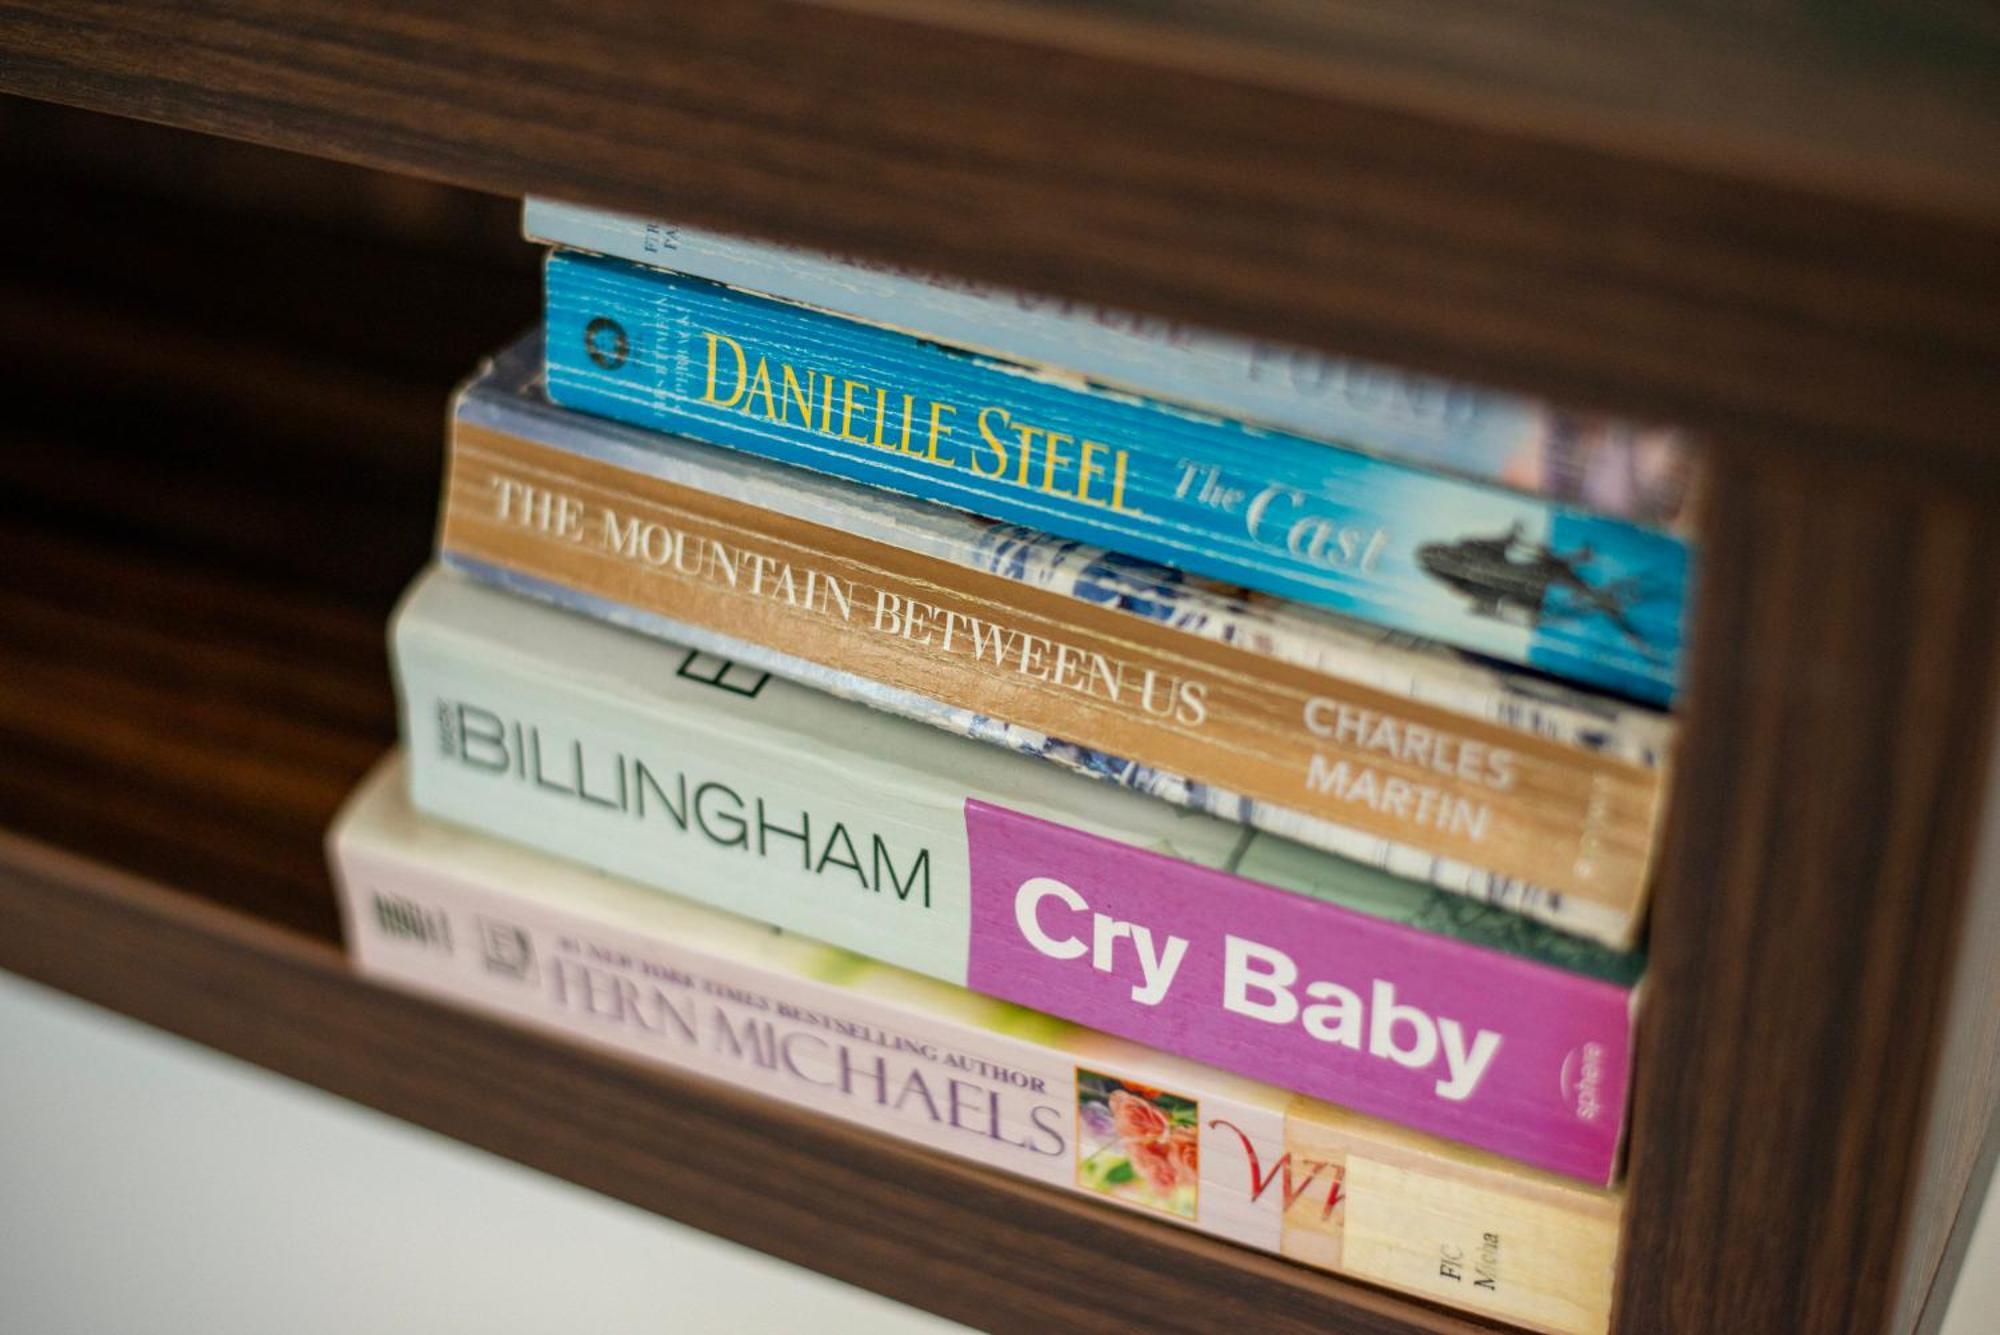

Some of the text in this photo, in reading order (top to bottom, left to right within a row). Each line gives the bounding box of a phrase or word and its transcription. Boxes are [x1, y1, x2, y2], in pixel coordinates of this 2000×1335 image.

[701, 332, 958, 468] DANIELLE
[971, 406, 1144, 517] STEEL
[1173, 456, 1389, 575] The Cast
[492, 474, 585, 542] THE
[602, 508, 854, 621] MOUNTAIN
[873, 590, 1125, 702] BETWEEN
[1140, 670, 1210, 727] US
[1303, 696, 1517, 792] CHARLES
[1305, 753, 1491, 841] MARTIN
[457, 702, 931, 909] BILLINGHAM
[775, 1000, 939, 1062] BESTSELLING
[943, 1052, 1047, 1095] AUTHOR
[1014, 876, 1501, 1101] Cry Baby
[714, 1004, 1066, 1157] MICHAELS
[1575, 1041, 1602, 1120] sphere
[1439, 1243, 1463, 1281] FIC
